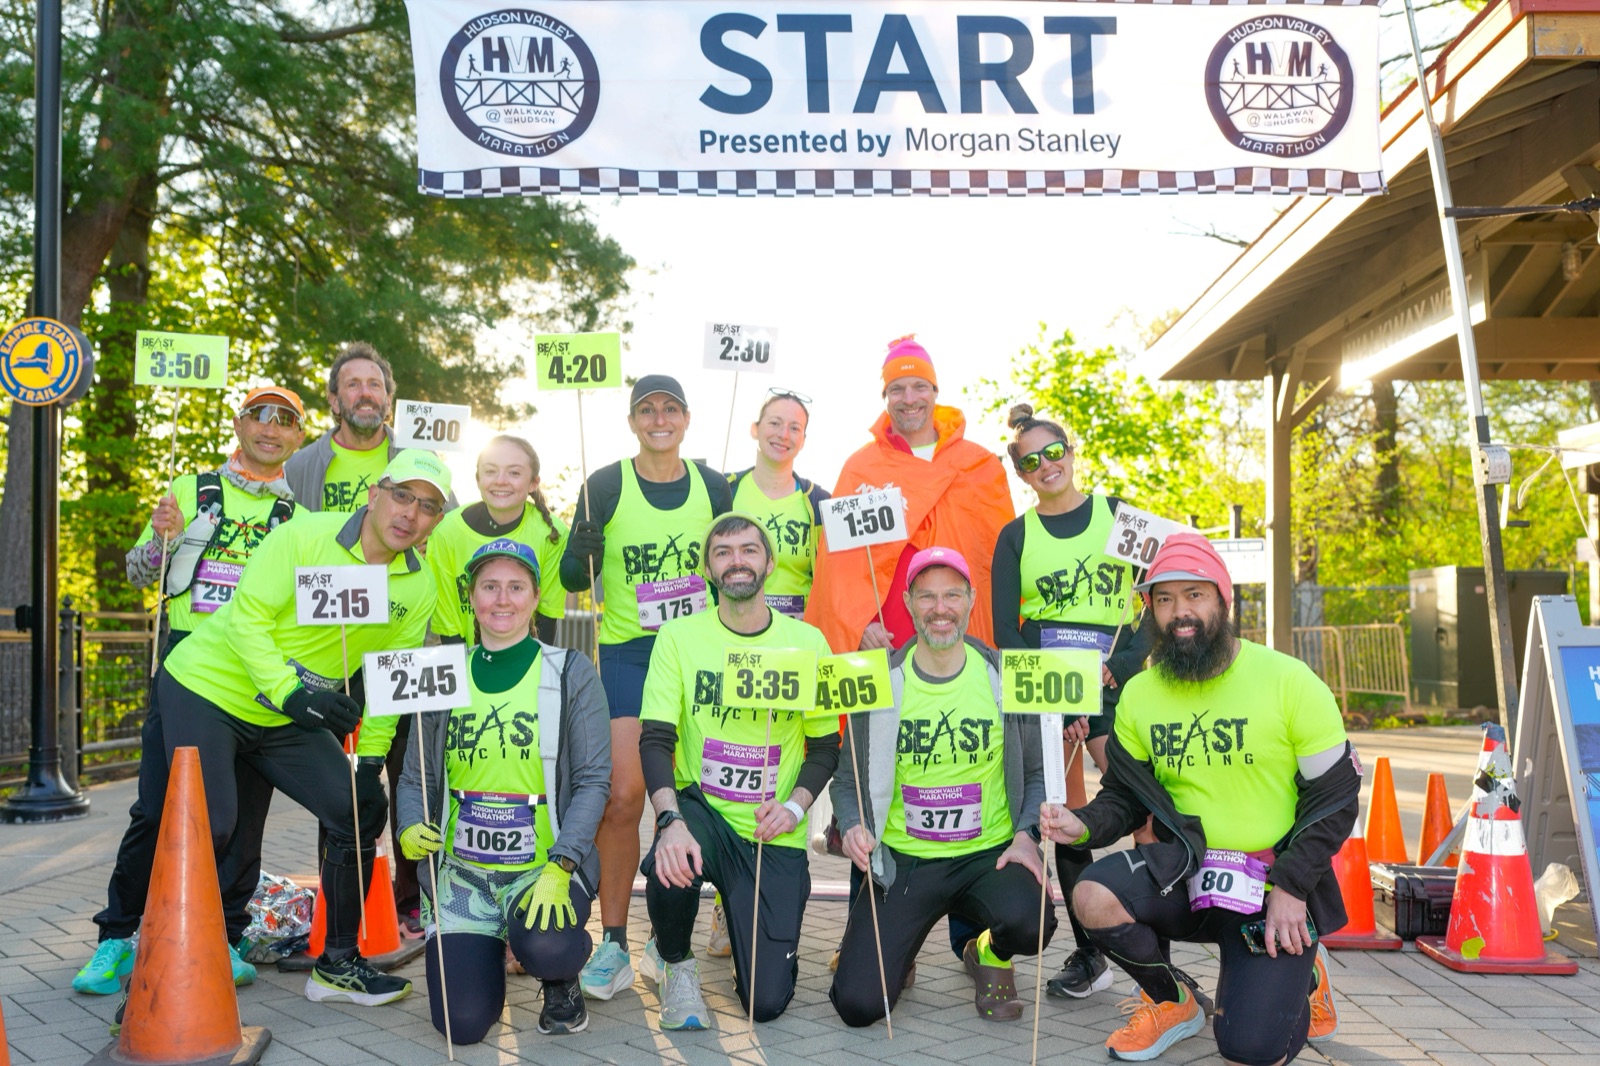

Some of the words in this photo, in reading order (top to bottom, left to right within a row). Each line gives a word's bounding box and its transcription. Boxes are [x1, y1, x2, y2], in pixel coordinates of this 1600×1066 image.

[464, 12, 520, 39] HUDSON
[524, 12, 575, 41] VALLEY
[1228, 17, 1283, 44] HUDSON
[1286, 18, 1332, 46] VALLEY
[482, 36, 554, 74] HVM
[699, 12, 1117, 115] START
[1245, 41, 1313, 77] HVM
[504, 108, 555, 117] WALKWAY
[1263, 109, 1314, 120] WALKWAY
[1273, 118, 1314, 127] HUDSON
[478, 131, 570, 155] MARATHON
[700, 129, 847, 154] Presented
[857, 130, 891, 158] by
[905, 127, 1010, 157] Morgan
[1017, 127, 1122, 158] Stanley
[1239, 133, 1326, 155] MARATHON
[1430, 274, 1473, 315] WET
[0, 323, 41, 355] EMPIRE
[43, 324, 76, 354] STATE
[713, 323, 740, 334] BEAST
[142, 337, 174, 349] BEAST
[537, 340, 570, 353] BEAST
[719, 336, 770, 364] 2:30
[150, 351, 211, 380] 3:50
[548, 354, 607, 384] 4:20
[18, 386, 58, 402] TRAIL
[406, 404, 432, 414] BEAST
[412, 416, 460, 443] 2:00
[324, 473, 369, 507] BEA
[843, 505, 895, 538] 1:50
[1118, 512, 1149, 529] BEAST
[622, 532, 701, 576] BEAS
[1117, 529, 1165, 564] 3:0
[207, 567, 243, 576] MARATHO
[230, 563, 245, 571] VALL
[298, 572, 332, 587] BEAST
[654, 583, 690, 594] MARATHON
[1036, 554, 1125, 606] BEAST
[203, 584, 236, 602] 29
[311, 588, 370, 619] 2:15
[657, 597, 693, 621] 175
[1056, 633, 1097, 643] MARATHON
[377, 652, 413, 667] BEAST
[728, 652, 762, 665] BEAST
[1004, 652, 1041, 667] BEAST
[390, 664, 457, 701] 2:45
[736, 668, 800, 701] 3:35
[816, 674, 877, 711] 4:05
[1015, 671, 1083, 704] 5:00
[692, 704, 794, 723] PACING
[445, 701, 538, 751] BEAS
[897, 708, 993, 754] BEAST
[1150, 709, 1248, 757] BEAST
[445, 748, 530, 762] PACIN
[724, 744, 747, 752] HUDSON
[724, 749, 766, 759] MARATHON
[719, 766, 762, 790] 375
[919, 792, 963, 800] MARATHON
[471, 804, 494, 814] HUDSON
[471, 810, 515, 821] MARATHON
[921, 808, 963, 829] 377
[465, 827, 522, 852] 1062
[1204, 854, 1247, 865] ARATHON
[1226, 851, 1248, 859] VALLEY
[1201, 870, 1233, 893] 80
